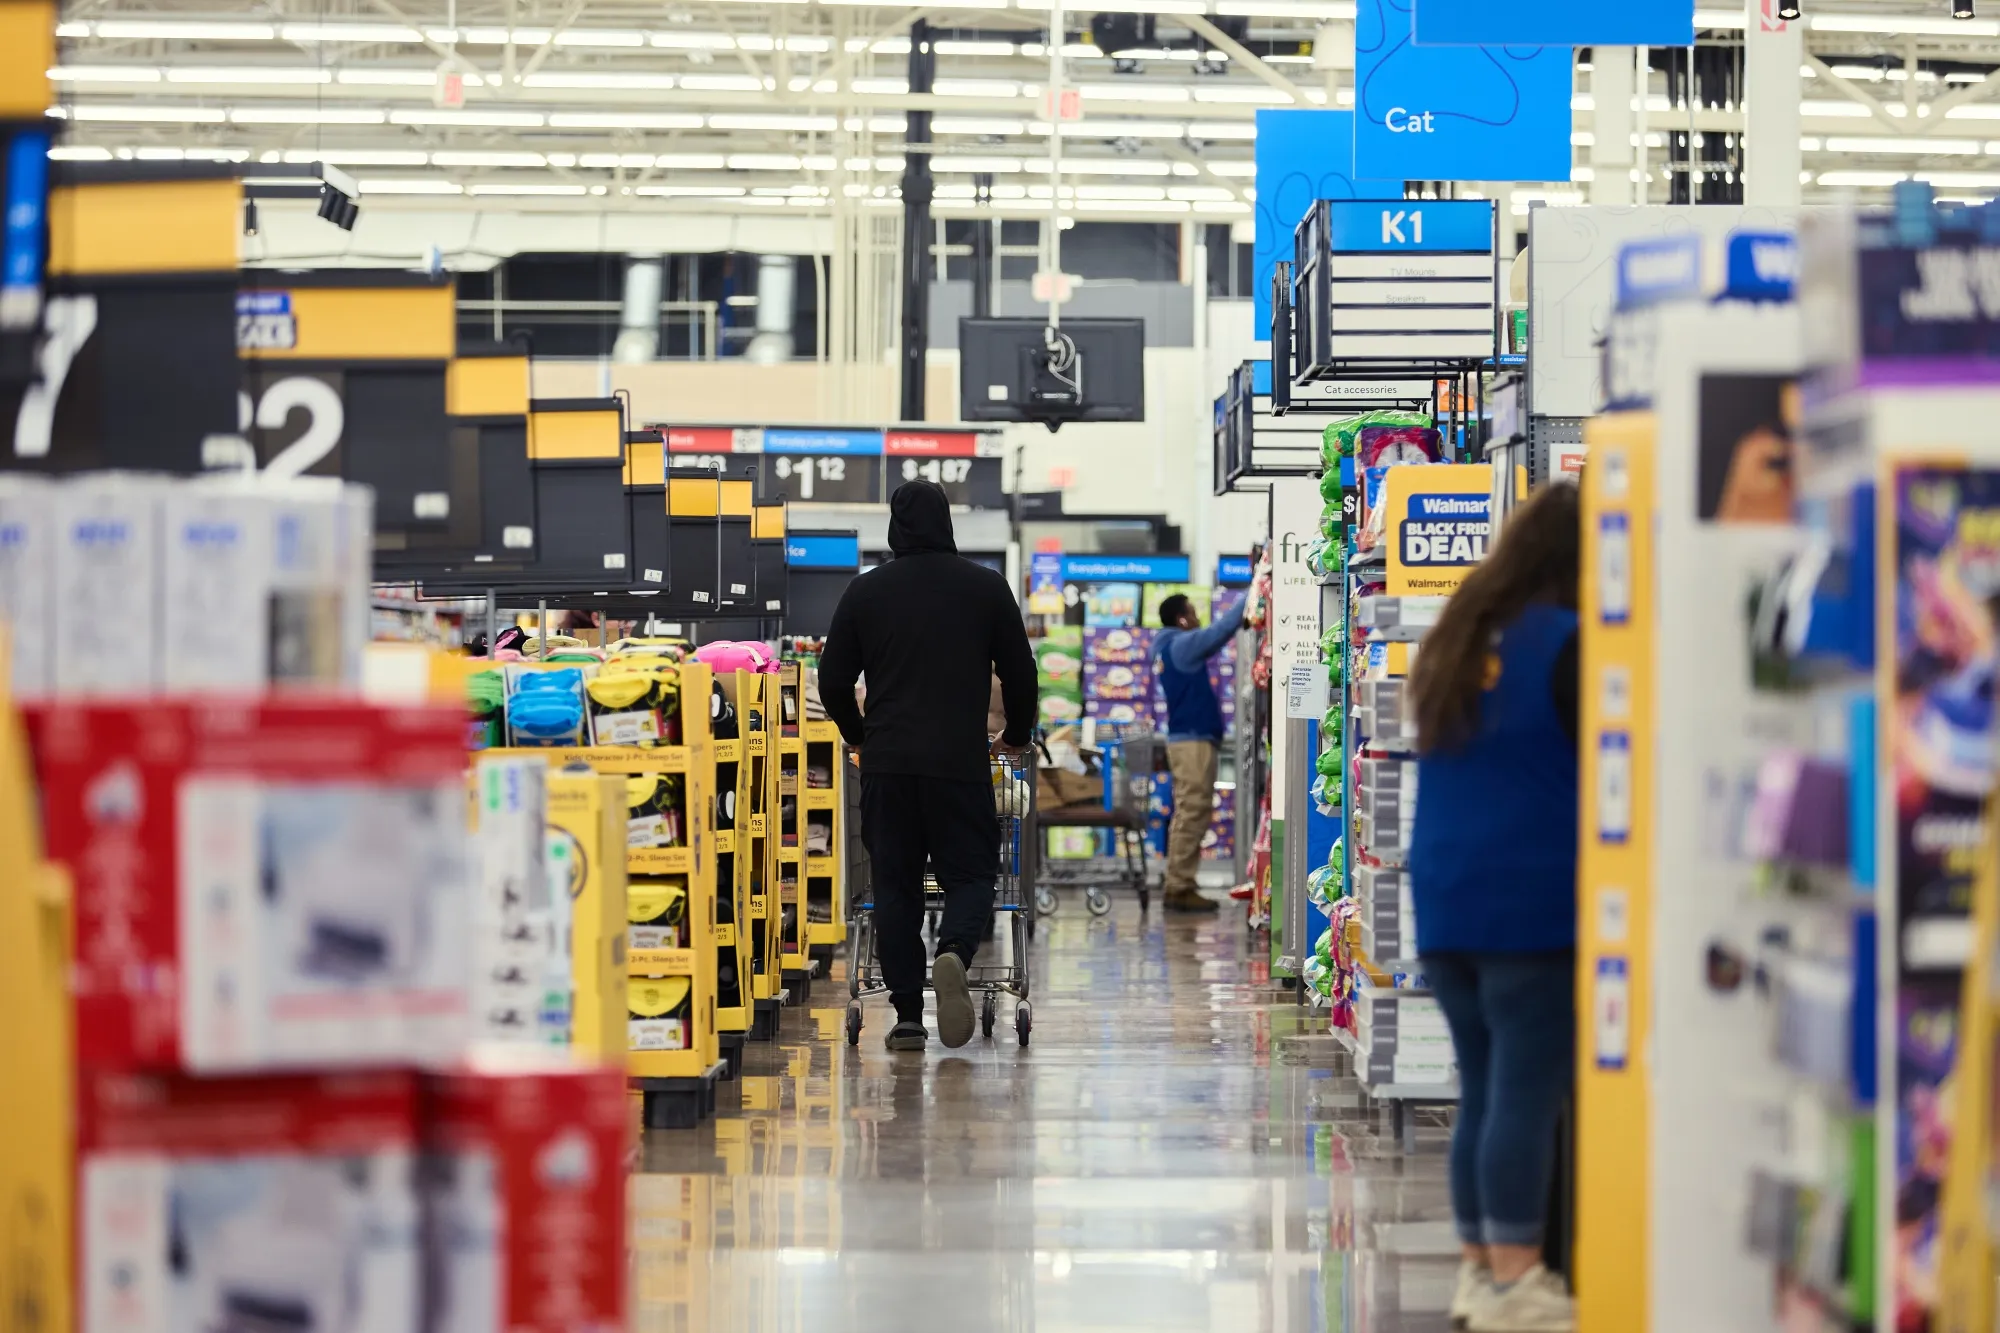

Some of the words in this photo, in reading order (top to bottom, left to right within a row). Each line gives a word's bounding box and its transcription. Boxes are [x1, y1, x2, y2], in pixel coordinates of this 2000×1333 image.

[1385, 107, 1434, 133] Cat
[1382, 210, 1422, 244] K1
[1390, 268, 1402, 276] TV
[1405, 268, 1437, 276] Mounts
[1386, 294, 1427, 304] Speakers
[1325, 386, 1342, 394] Cat
[1344, 386, 1398, 394] accessories
[1343, 494, 1355, 514] $
[1406, 522, 1455, 536] BLACK
[1408, 579, 1459, 588] Walmart+
